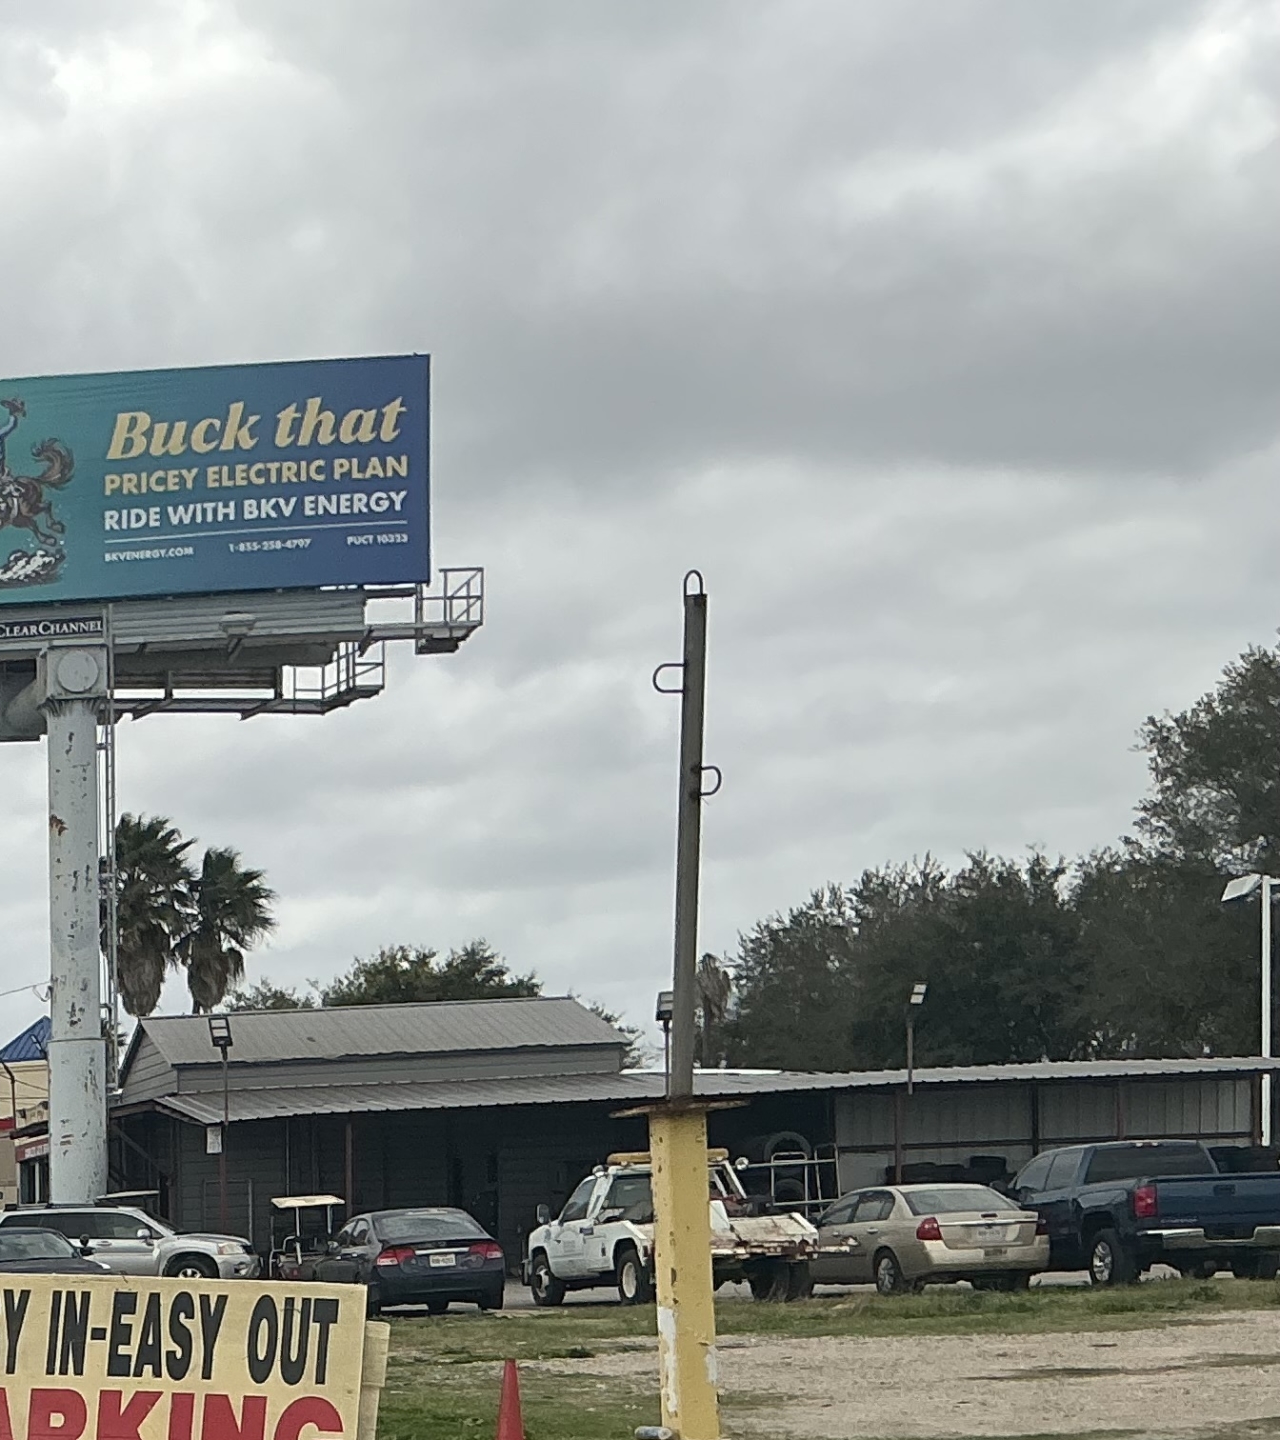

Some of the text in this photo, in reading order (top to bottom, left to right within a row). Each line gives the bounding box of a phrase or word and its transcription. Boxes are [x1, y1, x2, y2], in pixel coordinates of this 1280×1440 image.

[106, 397, 407, 460] Buck that
[105, 455, 408, 495] PRICEY ELECTRIC PLAN
[105, 491, 407, 531] RIDE WITH BKV ENERGY
[105, 547, 194, 562] BKVENERGY.COM
[46, 1290, 228, 1380] IN-EASY
[248, 1295, 338, 1385] OUT
